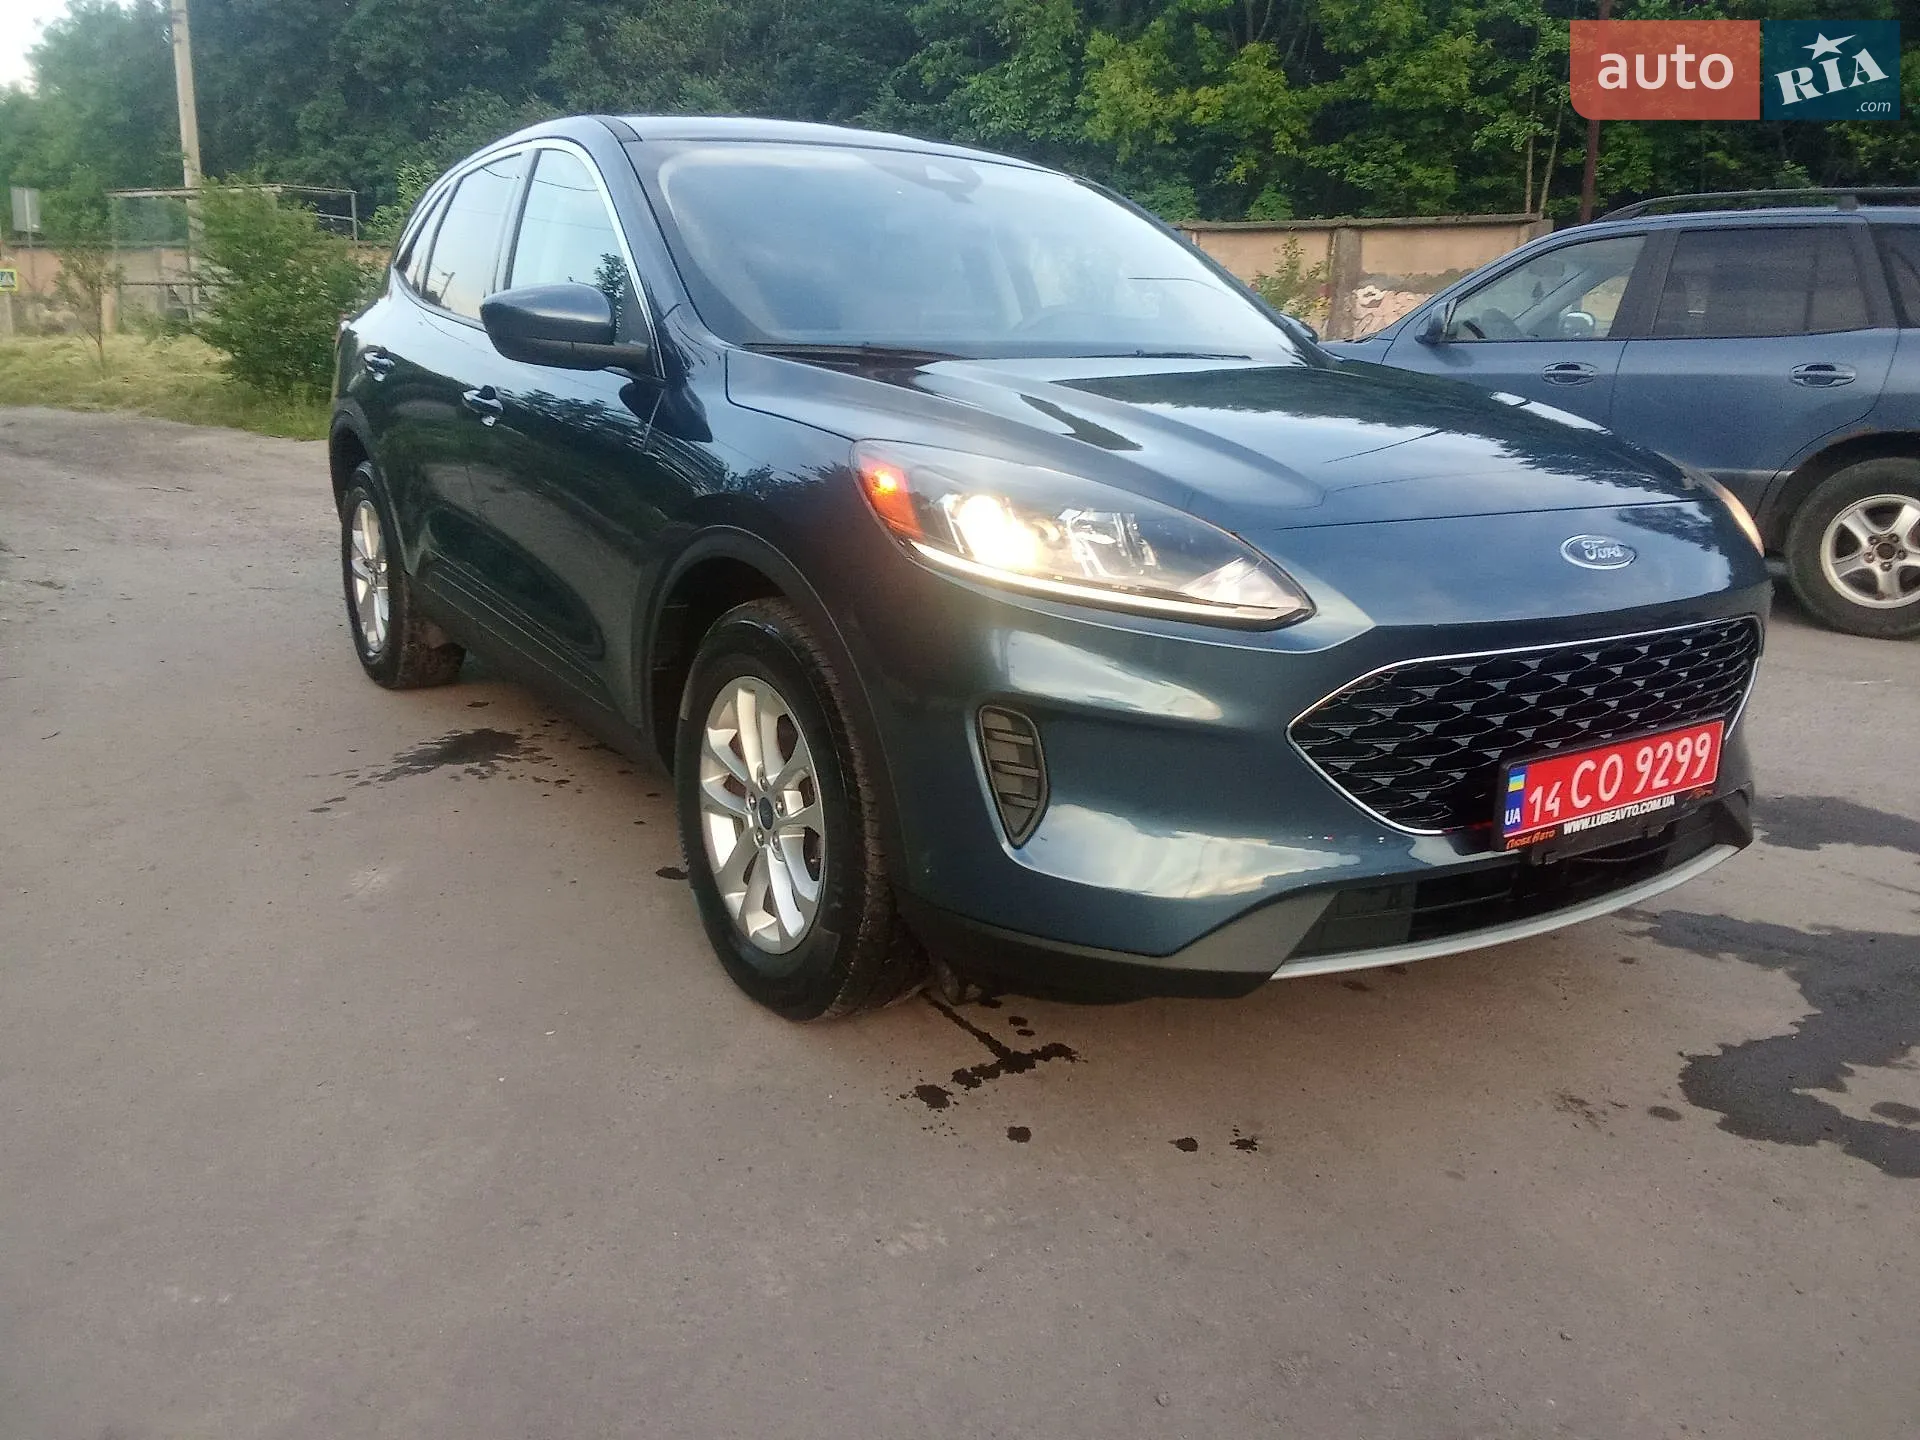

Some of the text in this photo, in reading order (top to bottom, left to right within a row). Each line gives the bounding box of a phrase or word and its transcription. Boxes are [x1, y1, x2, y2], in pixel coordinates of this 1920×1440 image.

[1581, 540, 1625, 560] Ford
[1528, 731, 1712, 823] 14 CO 9299
[1504, 809, 1521, 826] UA
[1563, 794, 1675, 835] WWW.LUBEAVTO.COM.UA
